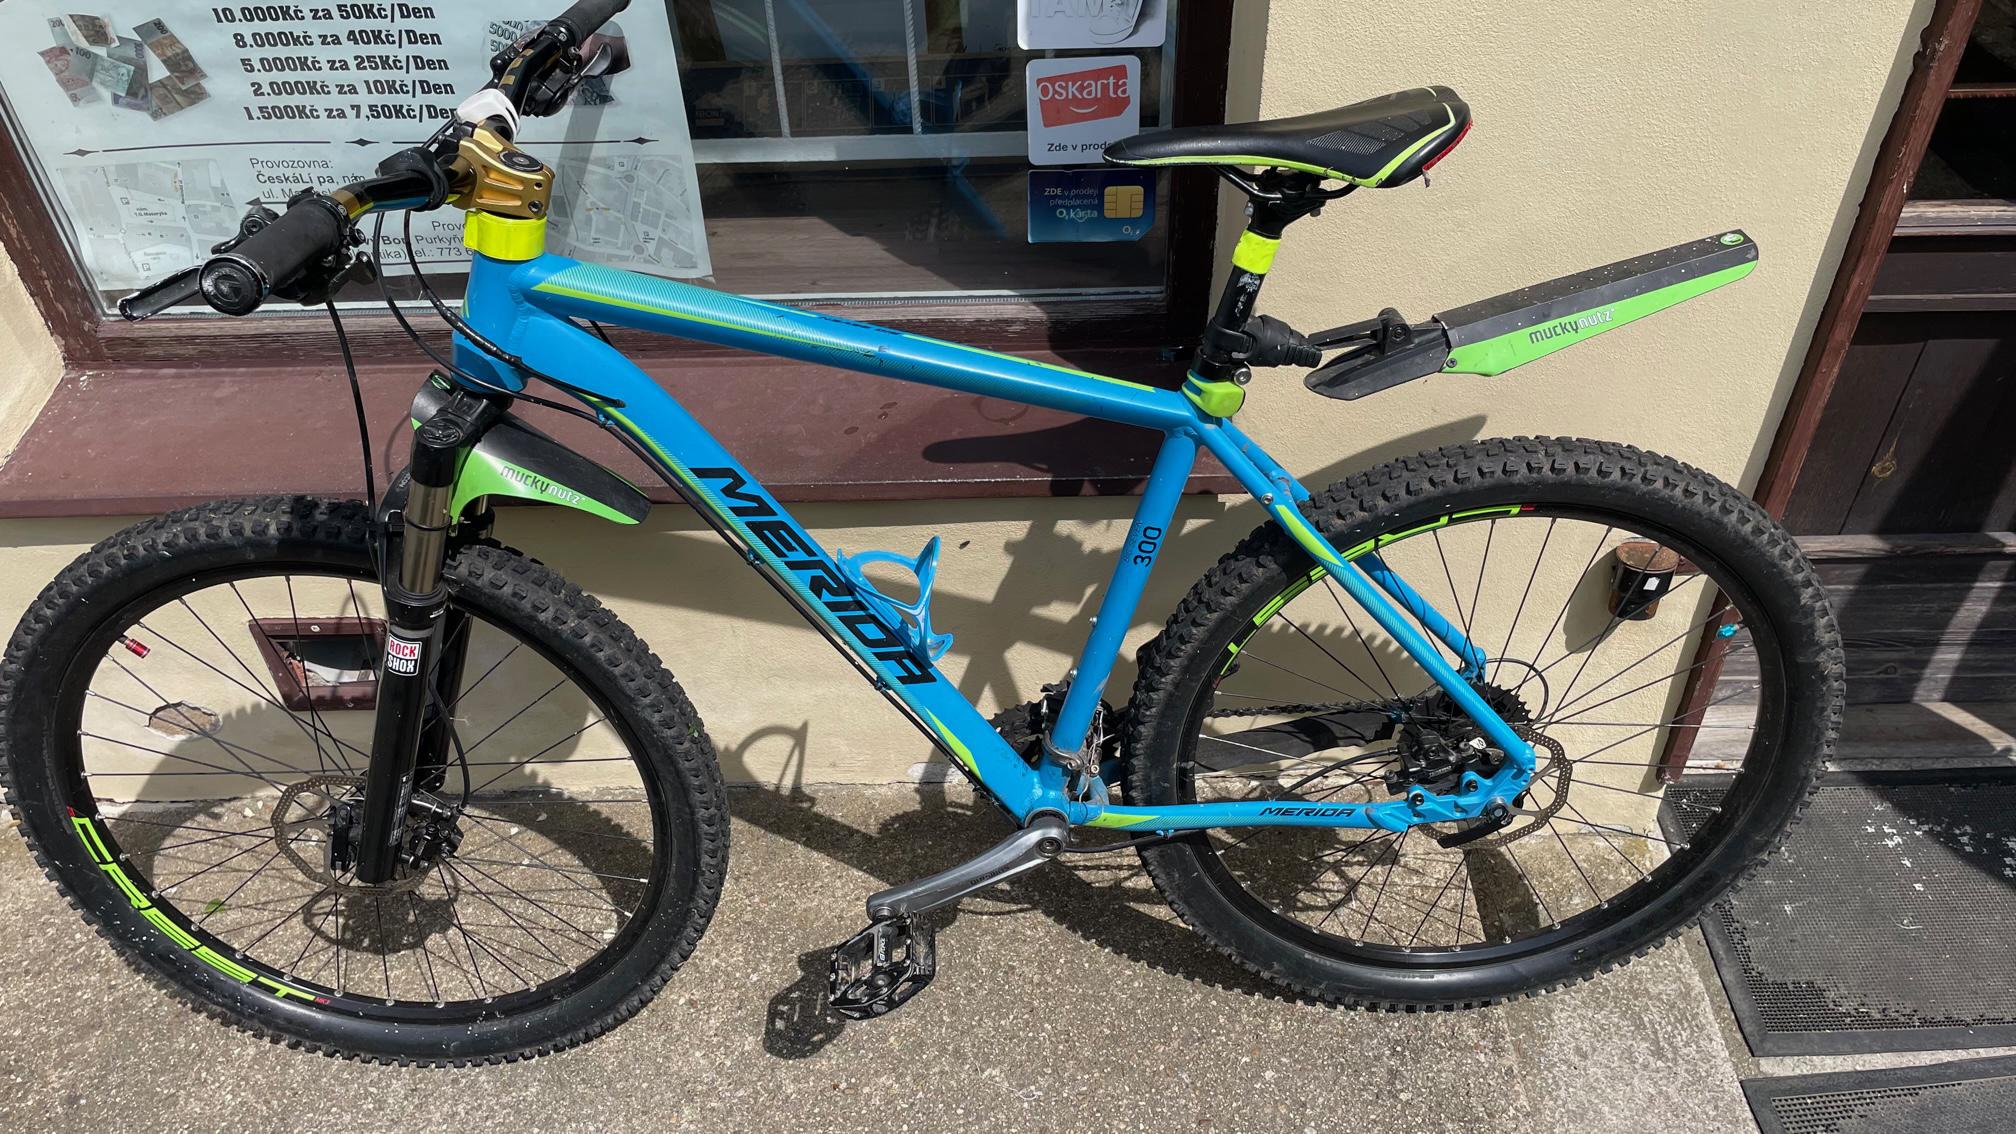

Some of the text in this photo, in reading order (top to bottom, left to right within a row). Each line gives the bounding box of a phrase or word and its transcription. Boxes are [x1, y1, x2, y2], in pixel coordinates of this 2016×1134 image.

[212, 3, 305, 24] 10.000Kč
[310, 8, 333, 21] za
[318, 32, 342, 46] za
[240, 55, 322, 73] 5.000Kč
[327, 58, 350, 71] za
[250, 80, 331, 97] 2.000Kč
[335, 82, 358, 95] za
[1038, 75, 1129, 100] oskarta
[243, 104, 320, 121] 1.500Kč
[324, 107, 347, 119] za
[1047, 143, 1068, 152] Zde
[249, 158, 334, 169] Provozovna:
[262, 189, 279, 199] ul.
[1044, 187, 1063, 196] ZDE
[436, 247, 462, 257] 773
[1528, 312, 1614, 345] muckynutz
[500, 464, 581, 506] muckynutz
[1133, 525, 1162, 568] 300
[688, 467, 938, 686] MERIDA
[389, 640, 417, 658] ROCK
[387, 654, 415, 673] SHOX
[1259, 807, 1356, 817] MERIDA
